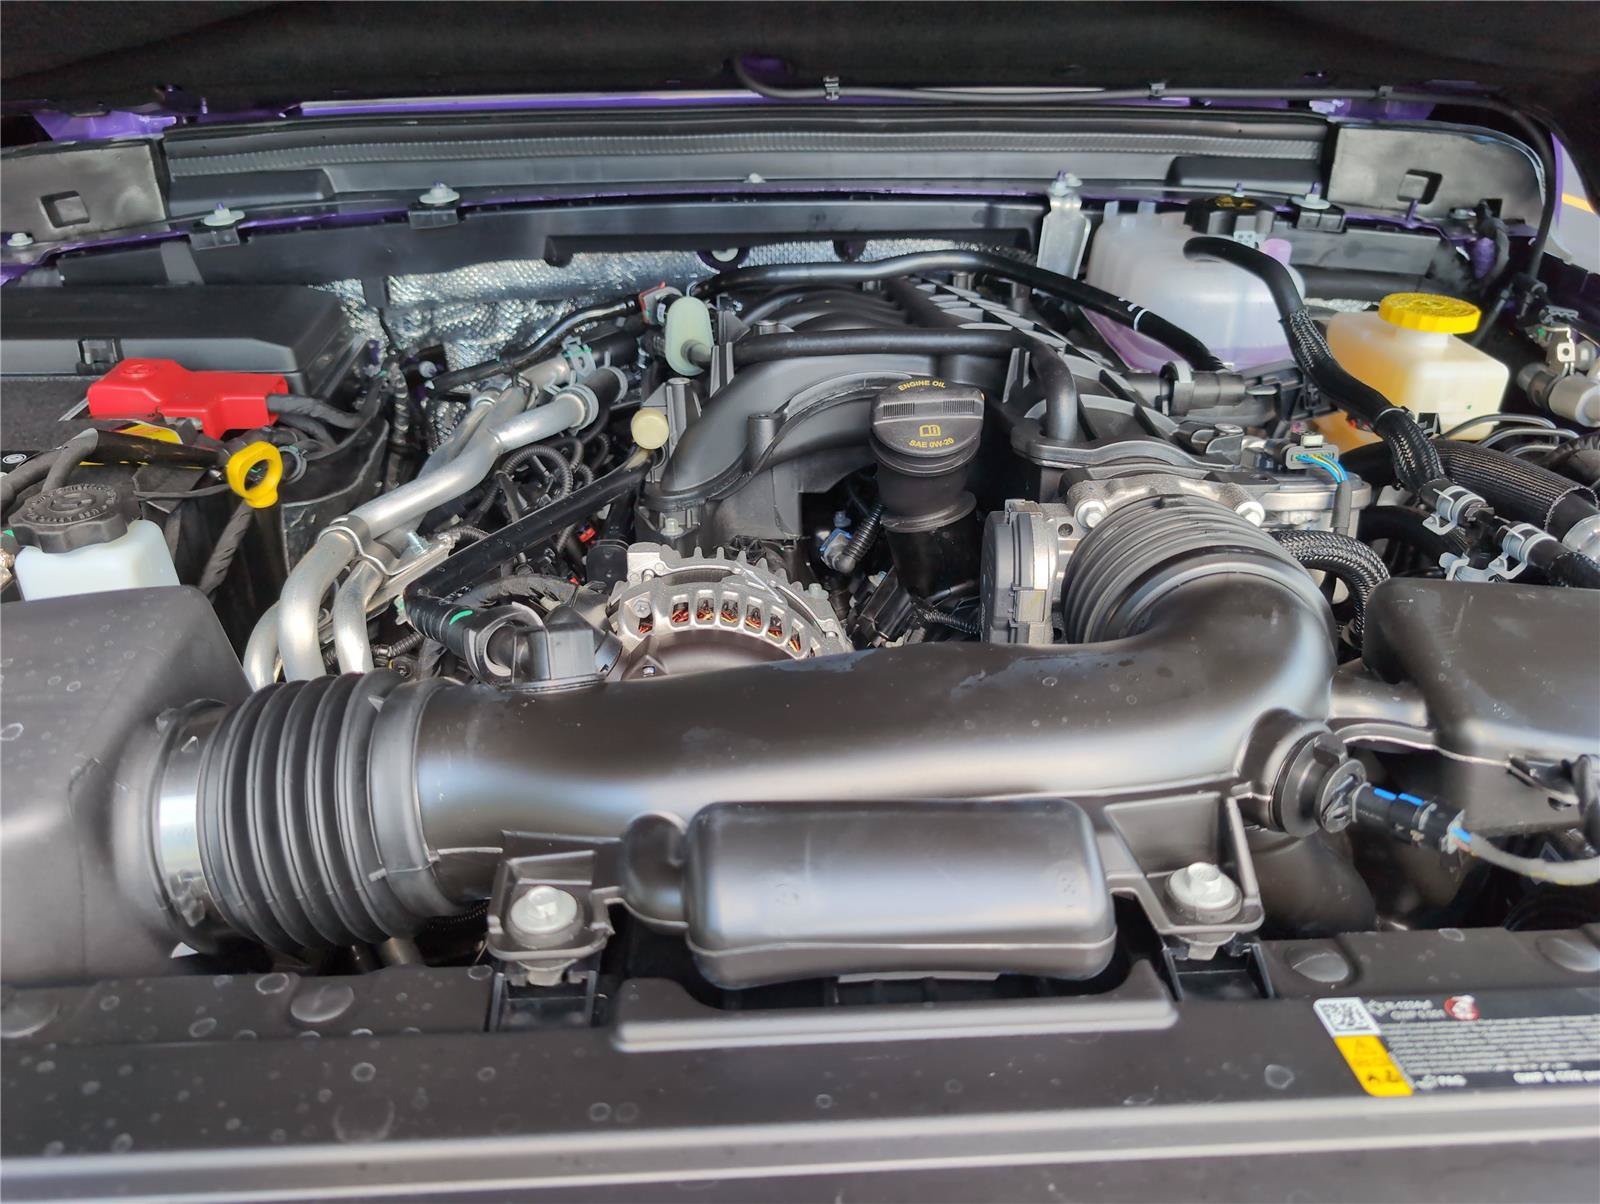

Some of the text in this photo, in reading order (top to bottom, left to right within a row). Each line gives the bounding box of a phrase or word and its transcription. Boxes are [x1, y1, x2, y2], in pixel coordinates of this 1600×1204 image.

[898, 380, 946, 391] ENGINE OIL
[909, 437, 955, 448] SAE 0W-20
